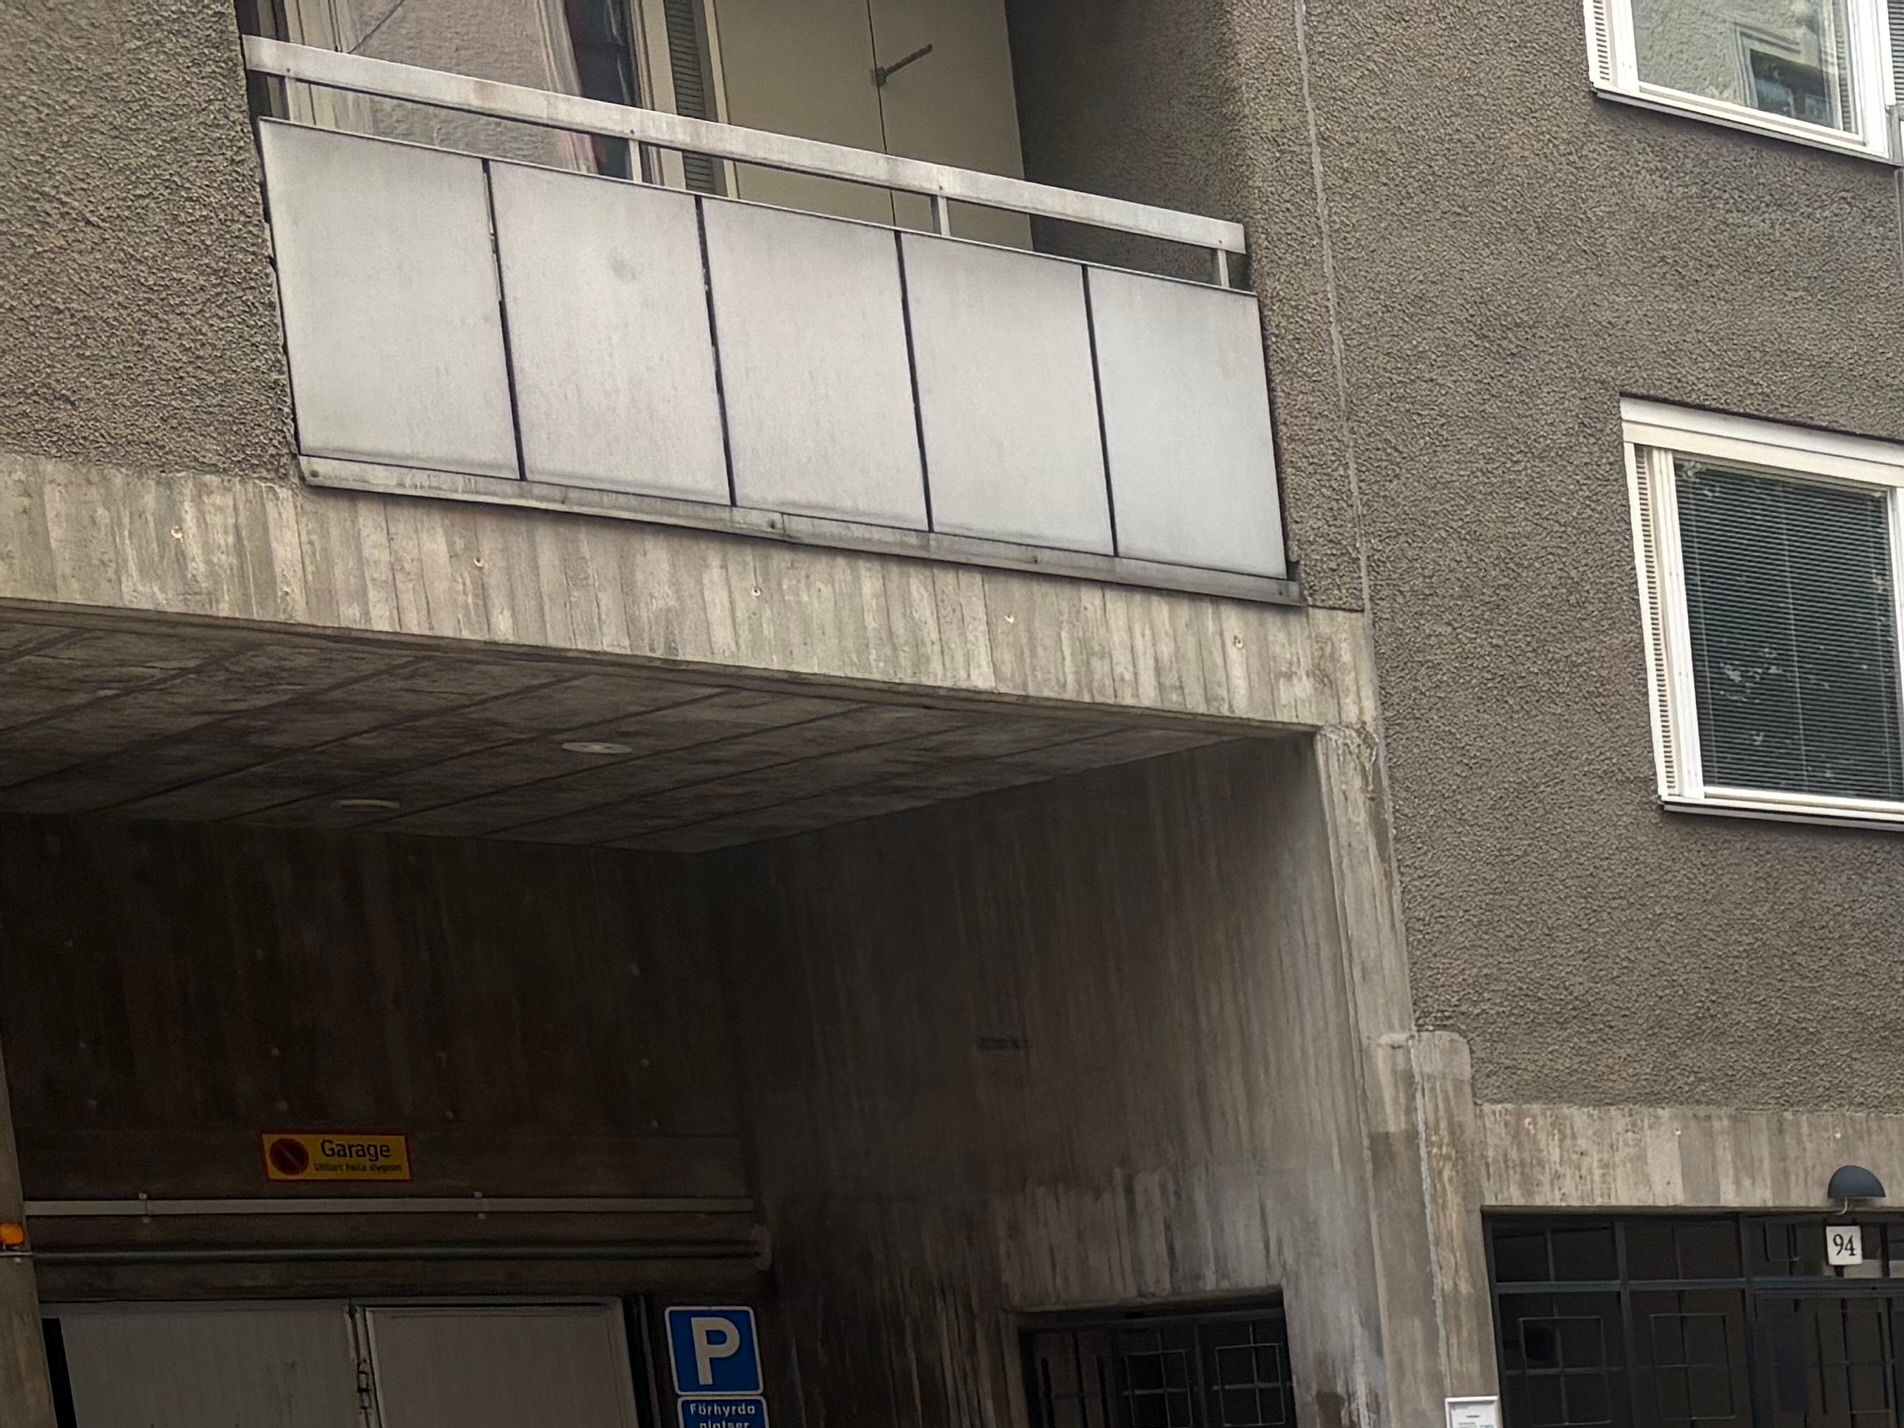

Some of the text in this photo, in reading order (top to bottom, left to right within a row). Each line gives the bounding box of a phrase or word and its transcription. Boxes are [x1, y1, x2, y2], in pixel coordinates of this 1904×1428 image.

[320, 1139, 391, 1162] Garage
[1833, 1233, 1857, 1256] 94
[691, 1317, 740, 1385] P
[689, 1402, 756, 1419] Förhyrda
